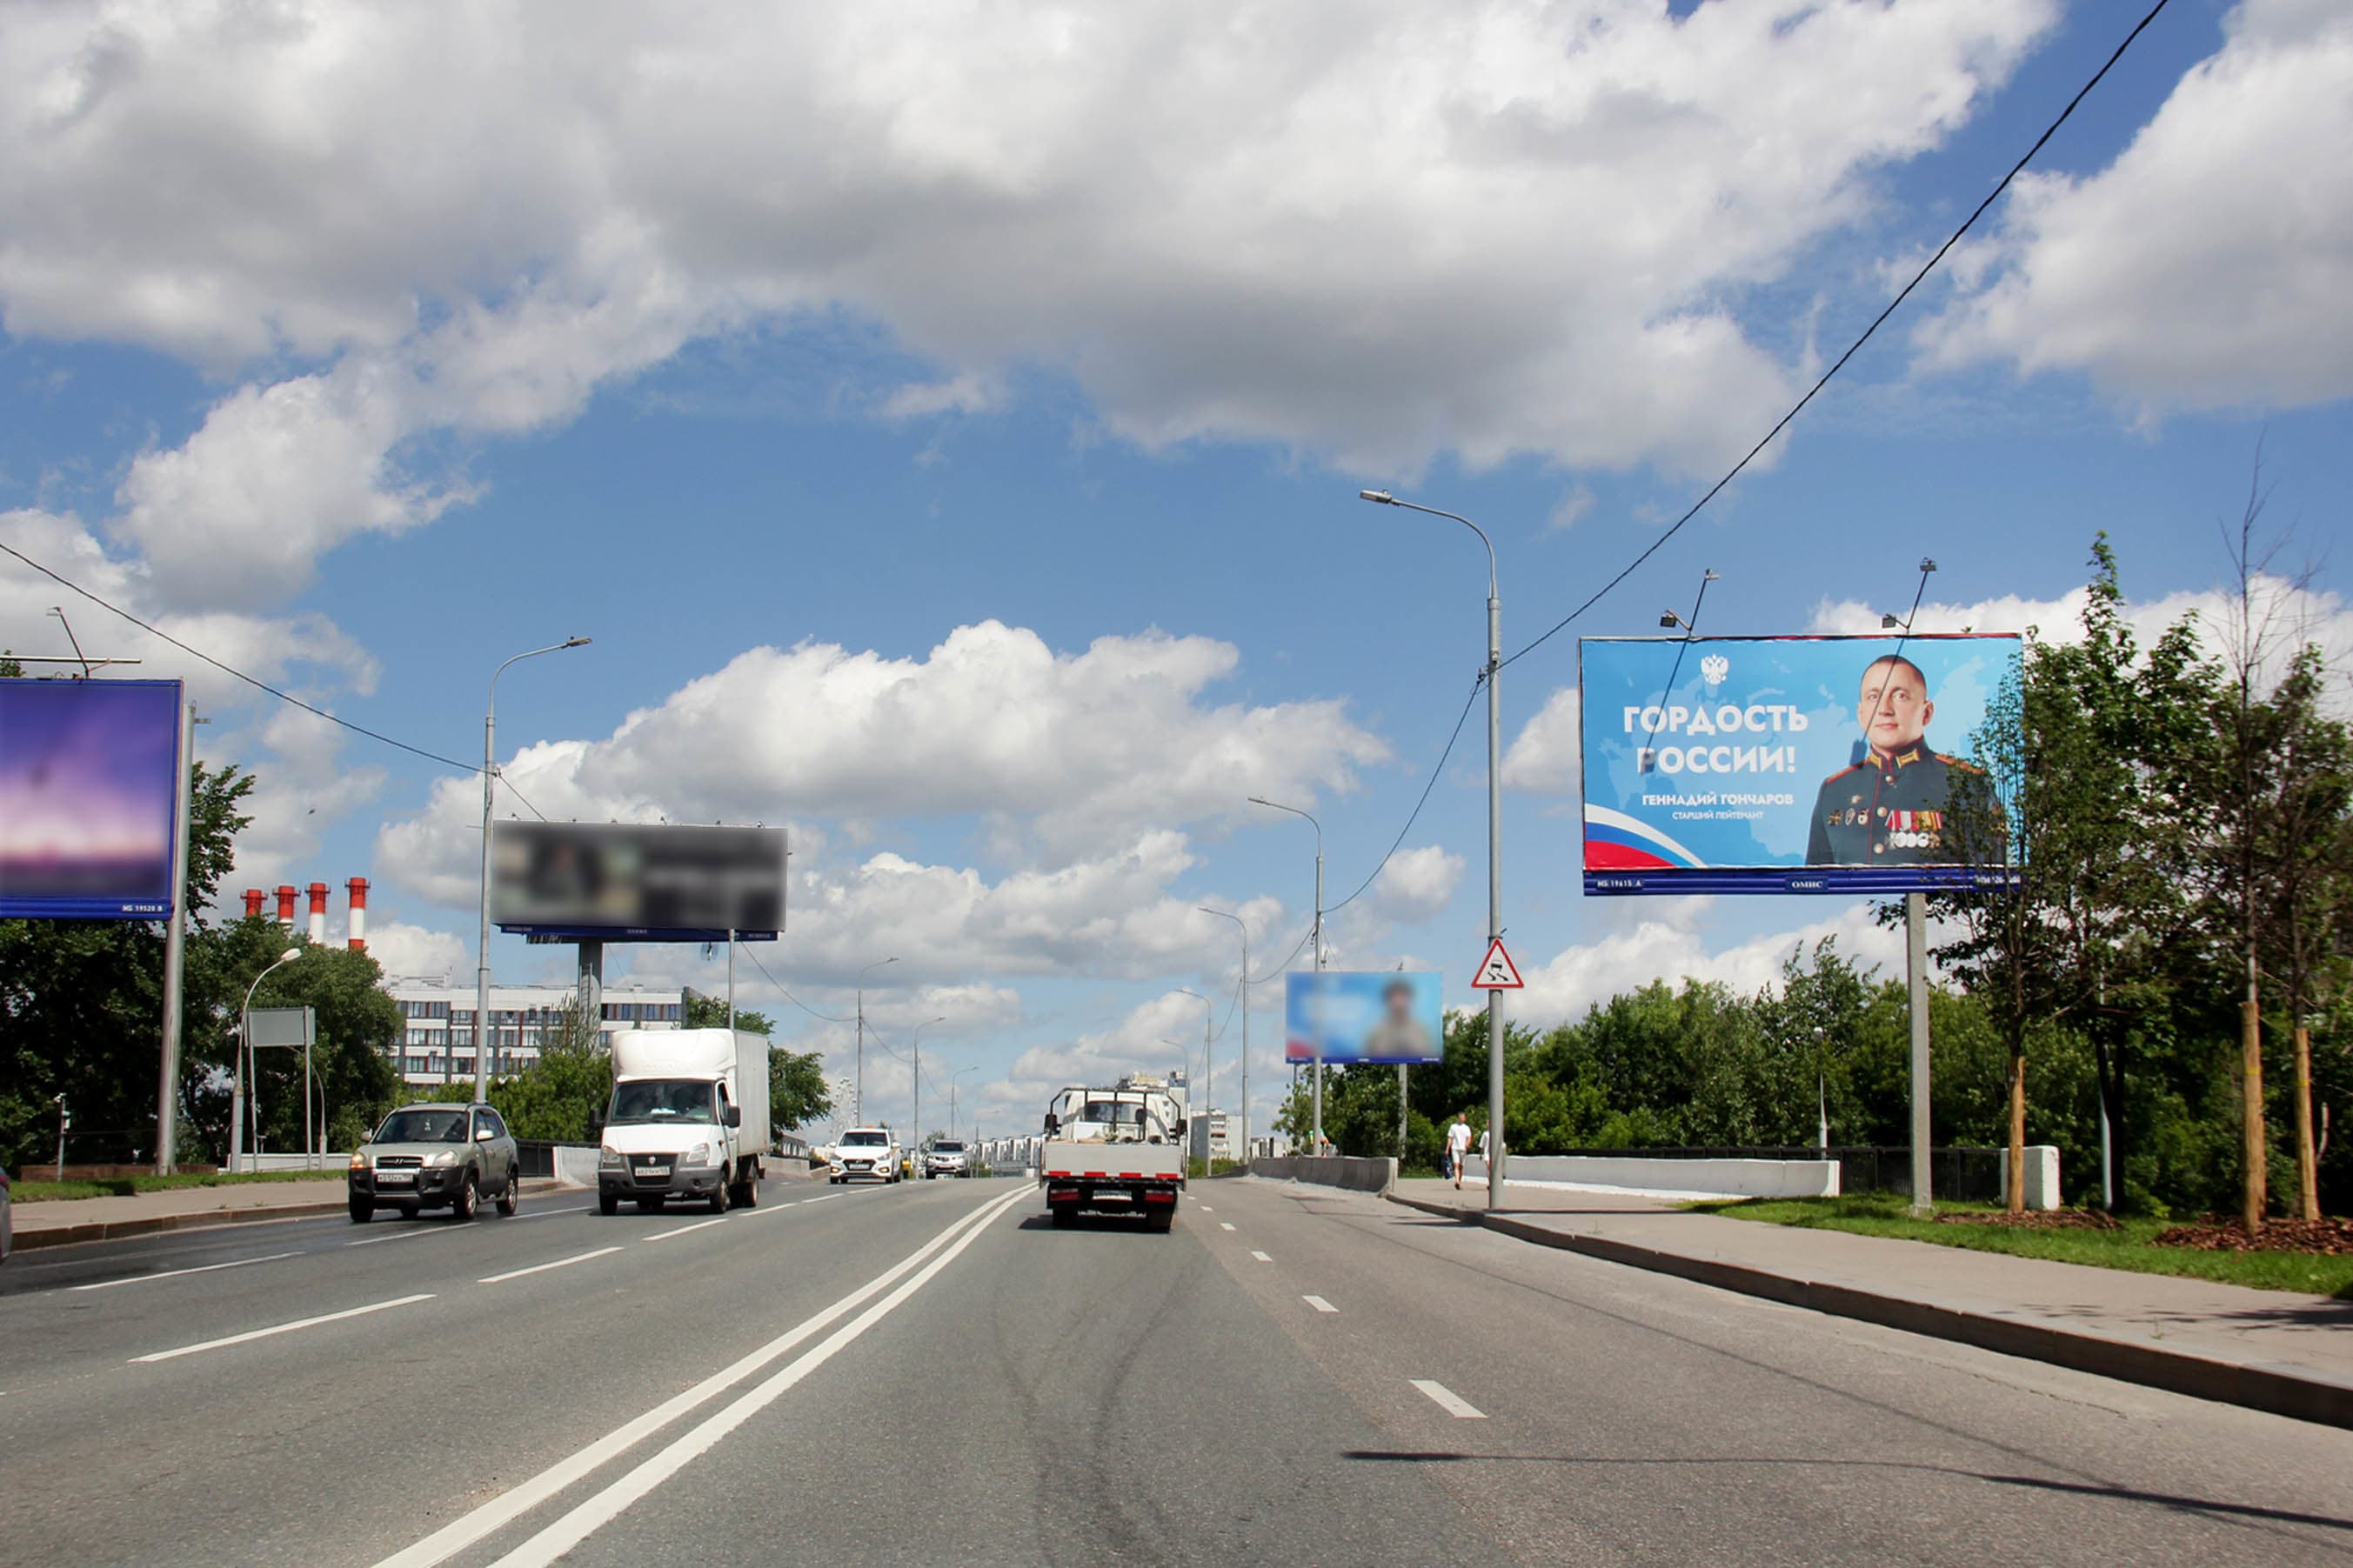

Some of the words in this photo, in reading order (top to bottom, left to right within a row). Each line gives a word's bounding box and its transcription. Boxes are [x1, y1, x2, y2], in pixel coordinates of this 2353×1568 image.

[1623, 704, 1809, 737] ГОРДОСТЬ
[1637, 745, 1796, 774] РОССИИ!
[1641, 791, 1717, 807] ГЕННАДИЙ
[1721, 793, 1795, 805] ГОНЧАРОВ
[1672, 810, 1714, 820] СТАРШИЙ
[1715, 810, 1764, 819] ЛЕЙТЕНАНТ
